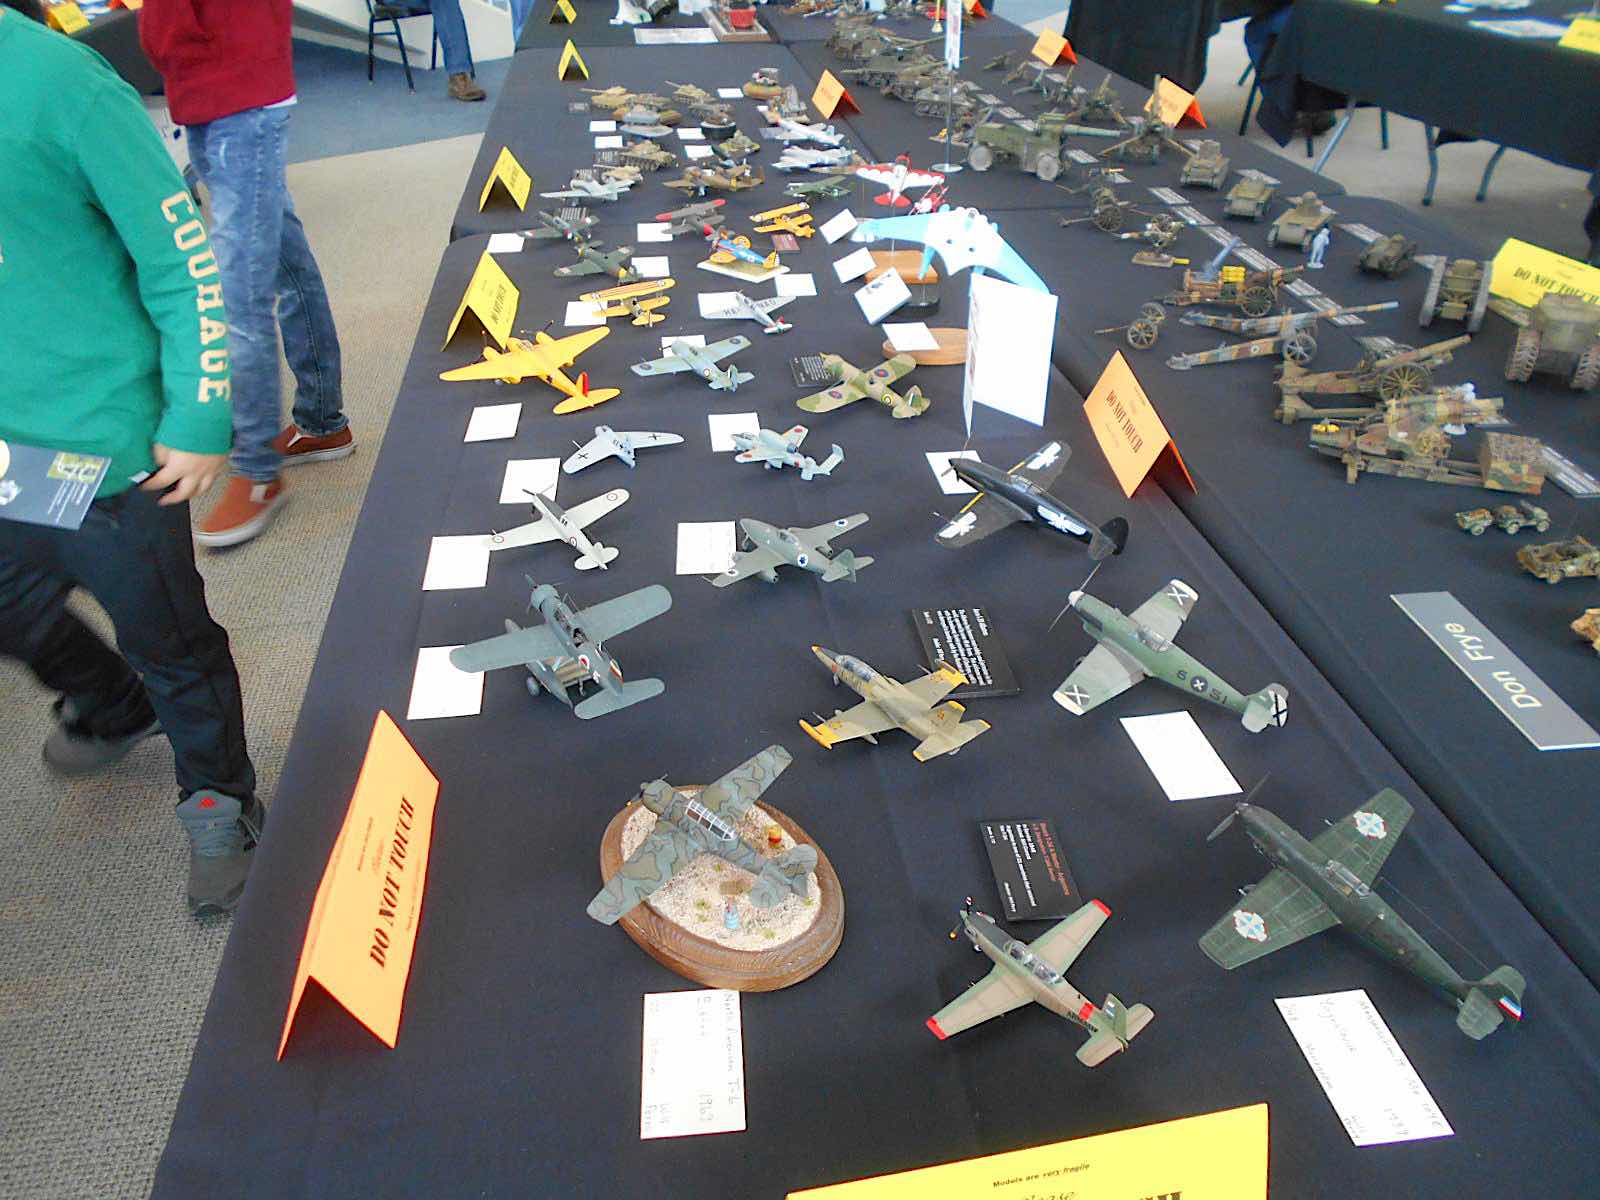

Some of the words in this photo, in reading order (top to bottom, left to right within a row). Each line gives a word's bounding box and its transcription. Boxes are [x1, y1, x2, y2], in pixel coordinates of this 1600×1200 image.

[161, 190, 232, 404] COURAGE
[1444, 623, 1496, 661] Frye
[1492, 671, 1543, 708] Don
[389, 796, 415, 872] TOUCH
[378, 872, 401, 927] NOT
[369, 927, 391, 968] DO
[992, 1176, 1023, 1188] Models
[1025, 1173, 1040, 1182] are
[1042, 1168, 1061, 1178] very
[1062, 1162, 1091, 1174] fragile
